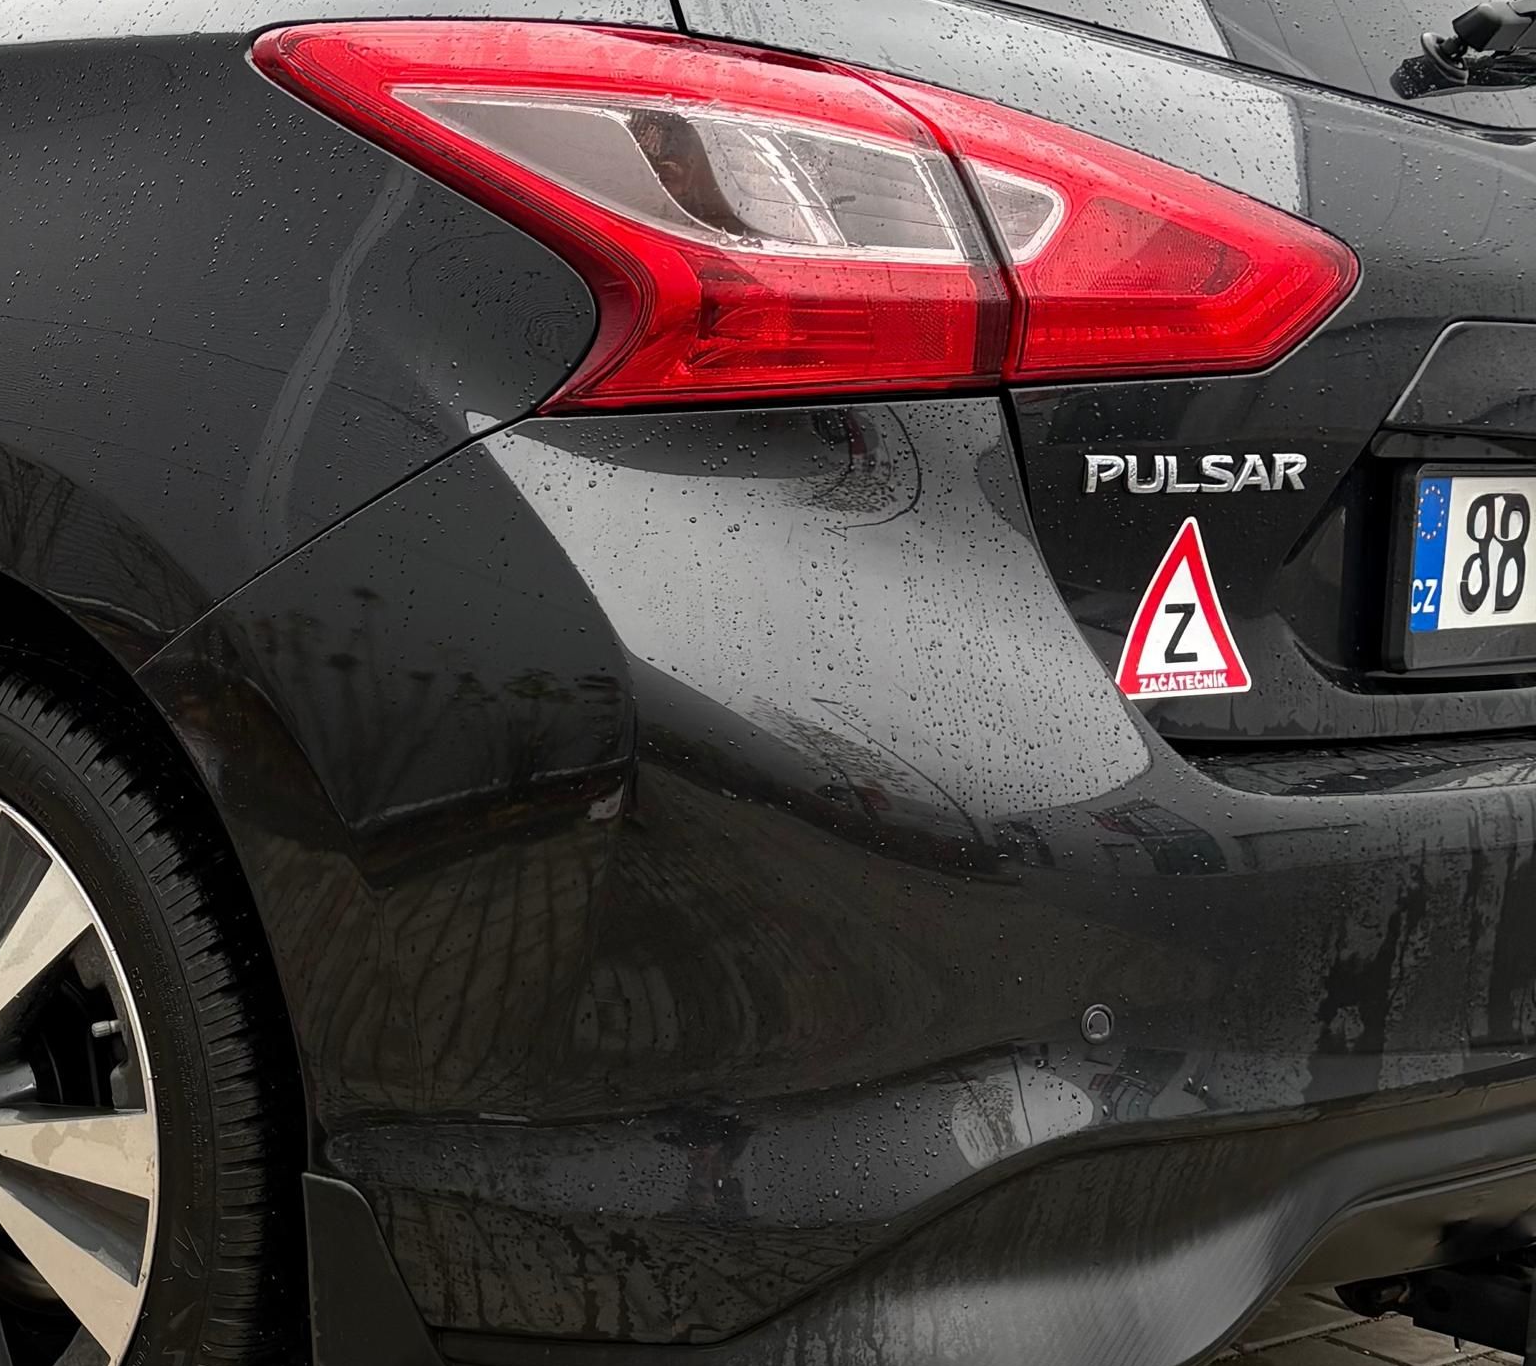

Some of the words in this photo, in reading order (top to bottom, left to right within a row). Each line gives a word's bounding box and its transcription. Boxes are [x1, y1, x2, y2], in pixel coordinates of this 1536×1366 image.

[1083, 453, 1308, 494] PULSAR
[1410, 578, 1438, 614] CZ
[1164, 602, 1198, 664] Z
[1138, 670, 1229, 693] ZAČÁTEČNÍK
